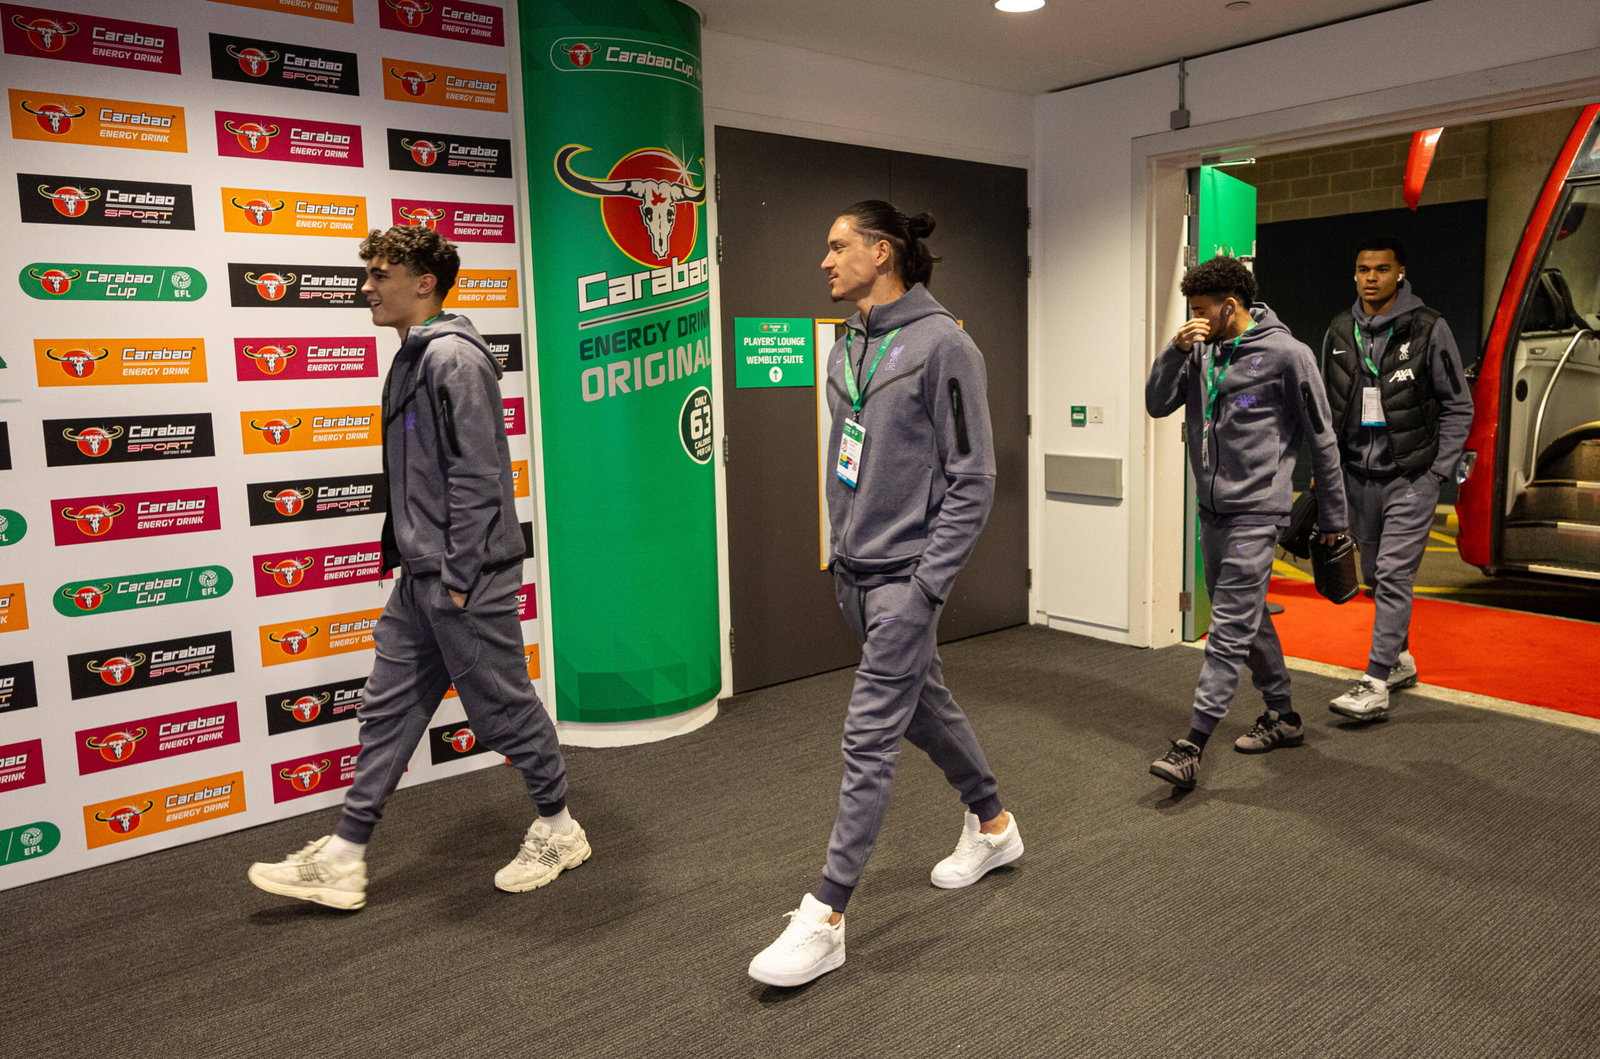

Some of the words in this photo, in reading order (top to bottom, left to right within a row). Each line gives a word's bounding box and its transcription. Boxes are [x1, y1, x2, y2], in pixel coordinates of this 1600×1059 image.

[314, 2, 339, 13] DRINK
[442, 6, 494, 25] Carabao
[92, 26, 165, 48] Carabao
[441, 23, 469, 34] ENERGY
[471, 27, 492, 38] DRINK
[92, 48, 131, 60] ENERGY
[134, 52, 162, 64] DRINK
[284, 54, 343, 72] Carabao
[606, 46, 673, 69] Carabao
[674, 58, 693, 78] Cup
[282, 71, 341, 84] SPORT
[446, 75, 498, 91] Carabao
[445, 92, 474, 102] ENERGY
[475, 95, 496, 104] DRINK
[99, 108, 172, 127] Carabao
[99, 130, 138, 141] ENERGY
[141, 133, 170, 143] DRINK
[290, 128, 351, 144] Carabao
[290, 145, 322, 157] ENERGY
[324, 148, 349, 159] DRINK
[449, 143, 498, 157] Carabao
[448, 160, 496, 169] SPORT
[106, 190, 175, 205] Carabao
[104, 209, 173, 220] SPORT
[296, 201, 357, 216] Carabao
[454, 210, 504, 223] Carabao
[296, 219, 327, 229] ENERGY
[329, 221, 353, 231] DRINK
[454, 227, 482, 235] ENERGY
[483, 228, 503, 236] DRINK
[86, 271, 154, 284] Carabao
[300, 274, 358, 287] Carabao
[457, 277, 508, 288] Carabao
[577, 256, 709, 313] Carabao
[106, 284, 137, 299] Cup
[174, 289, 191, 298] EFL
[299, 292, 356, 300] SPORT
[580, 320, 671, 361] ENERGY
[744, 336, 776, 346] PLAYERS'
[777, 337, 806, 346] LOUNGE
[121, 347, 193, 361] Carabao
[307, 345, 366, 358] Carabao
[307, 363, 338, 371] ENERGY
[340, 363, 364, 371] DRINK
[746, 356, 782, 365] WEMBLEY
[783, 355, 804, 364] SUITE
[122, 368, 160, 376] ENERGY
[162, 367, 190, 375] DRINK
[581, 336, 712, 402] ORIGINAL
[1389, 368, 1415, 383] AXA
[1231, 394, 1258, 408] AXA
[312, 414, 371, 428] Carabao
[690, 404, 711, 440] 63
[128, 424, 196, 438] Carabao
[312, 434, 344, 442] ENERGY
[346, 432, 369, 440] DRINK
[127, 441, 193, 453] SPORT
[317, 484, 373, 497] Carabao
[137, 498, 206, 514] Carabao
[316, 499, 371, 512] SPORT
[137, 518, 174, 530] ENERGY
[176, 516, 203, 526] DRINK
[324, 551, 380, 567] Carabao
[324, 570, 354, 580] ENERGY
[356, 568, 379, 577] DRINK
[117, 577, 182, 594] Carabao
[202, 586, 218, 596] EFL
[135, 591, 166, 605] Cup
[329, 618, 377, 635] Caraba
[330, 636, 360, 648] ENERGY
[151, 644, 216, 663] Carabao
[149, 660, 214, 678] SPORT
[334, 688, 364, 702] Cara
[333, 703, 362, 715] SPO
[159, 715, 225, 736] Carabao
[159, 738, 195, 751] ENERGY
[197, 731, 223, 743] DRINK
[0, 771, 25, 784] RINK
[340, 771, 356, 781] ENE
[165, 784, 232, 808] Carabao
[166, 809, 202, 822] ENERGY
[204, 801, 230, 814] DRINK
[24, 845, 43, 856] EFL
